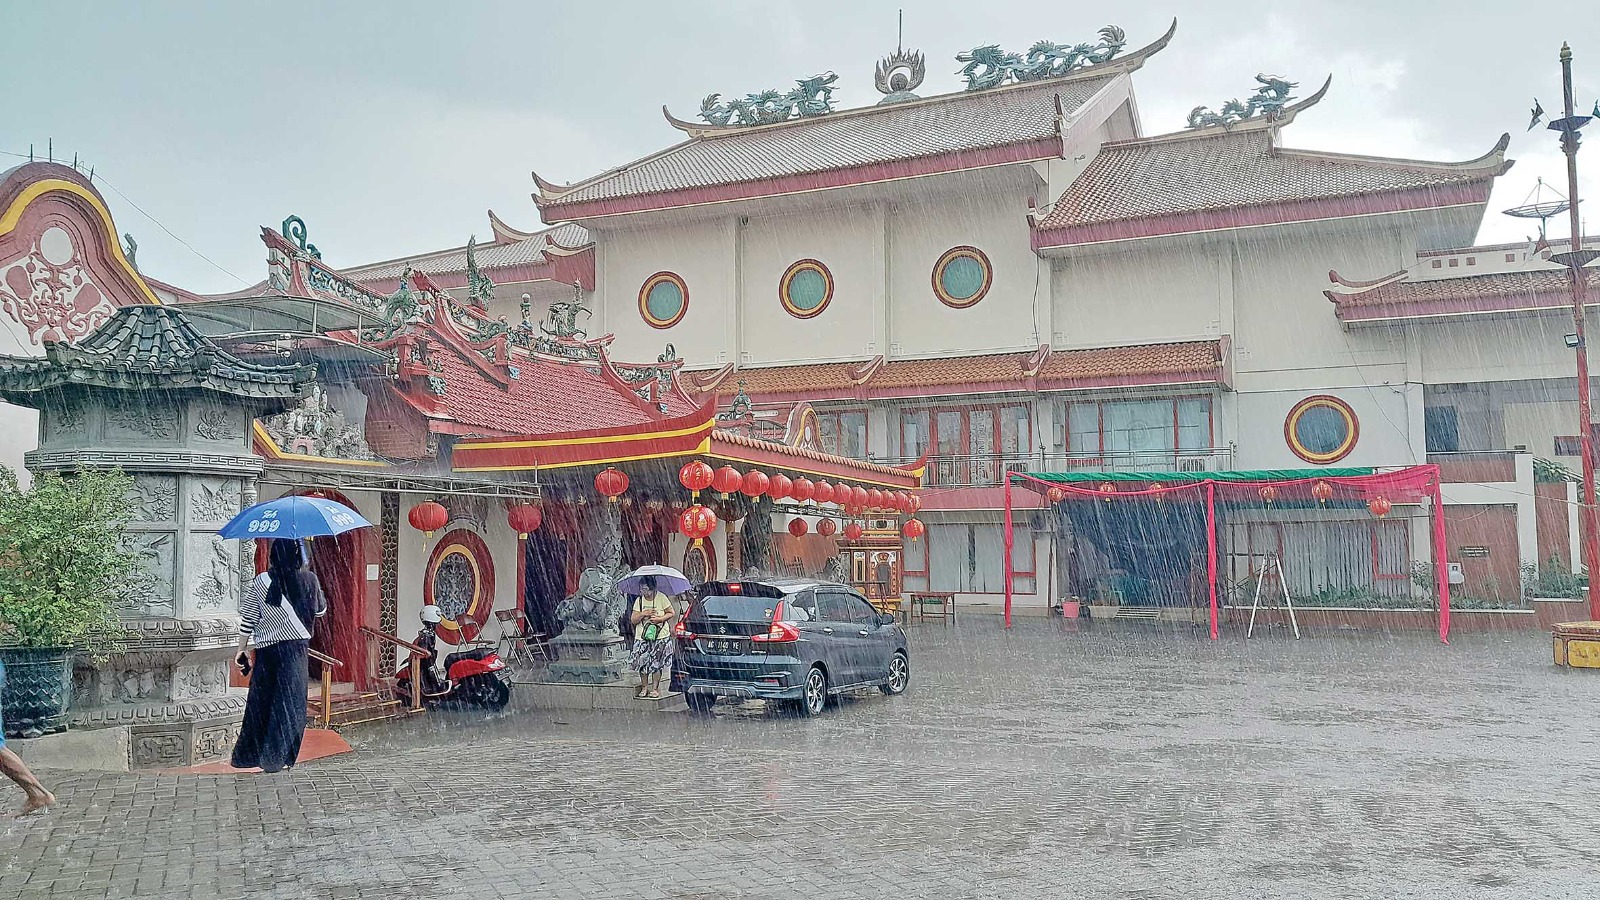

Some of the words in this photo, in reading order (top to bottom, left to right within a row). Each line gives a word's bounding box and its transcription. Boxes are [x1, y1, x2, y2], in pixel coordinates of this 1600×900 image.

[261, 509, 278, 519] Teh
[331, 513, 355, 527] 999
[248, 520, 280, 533] 999
